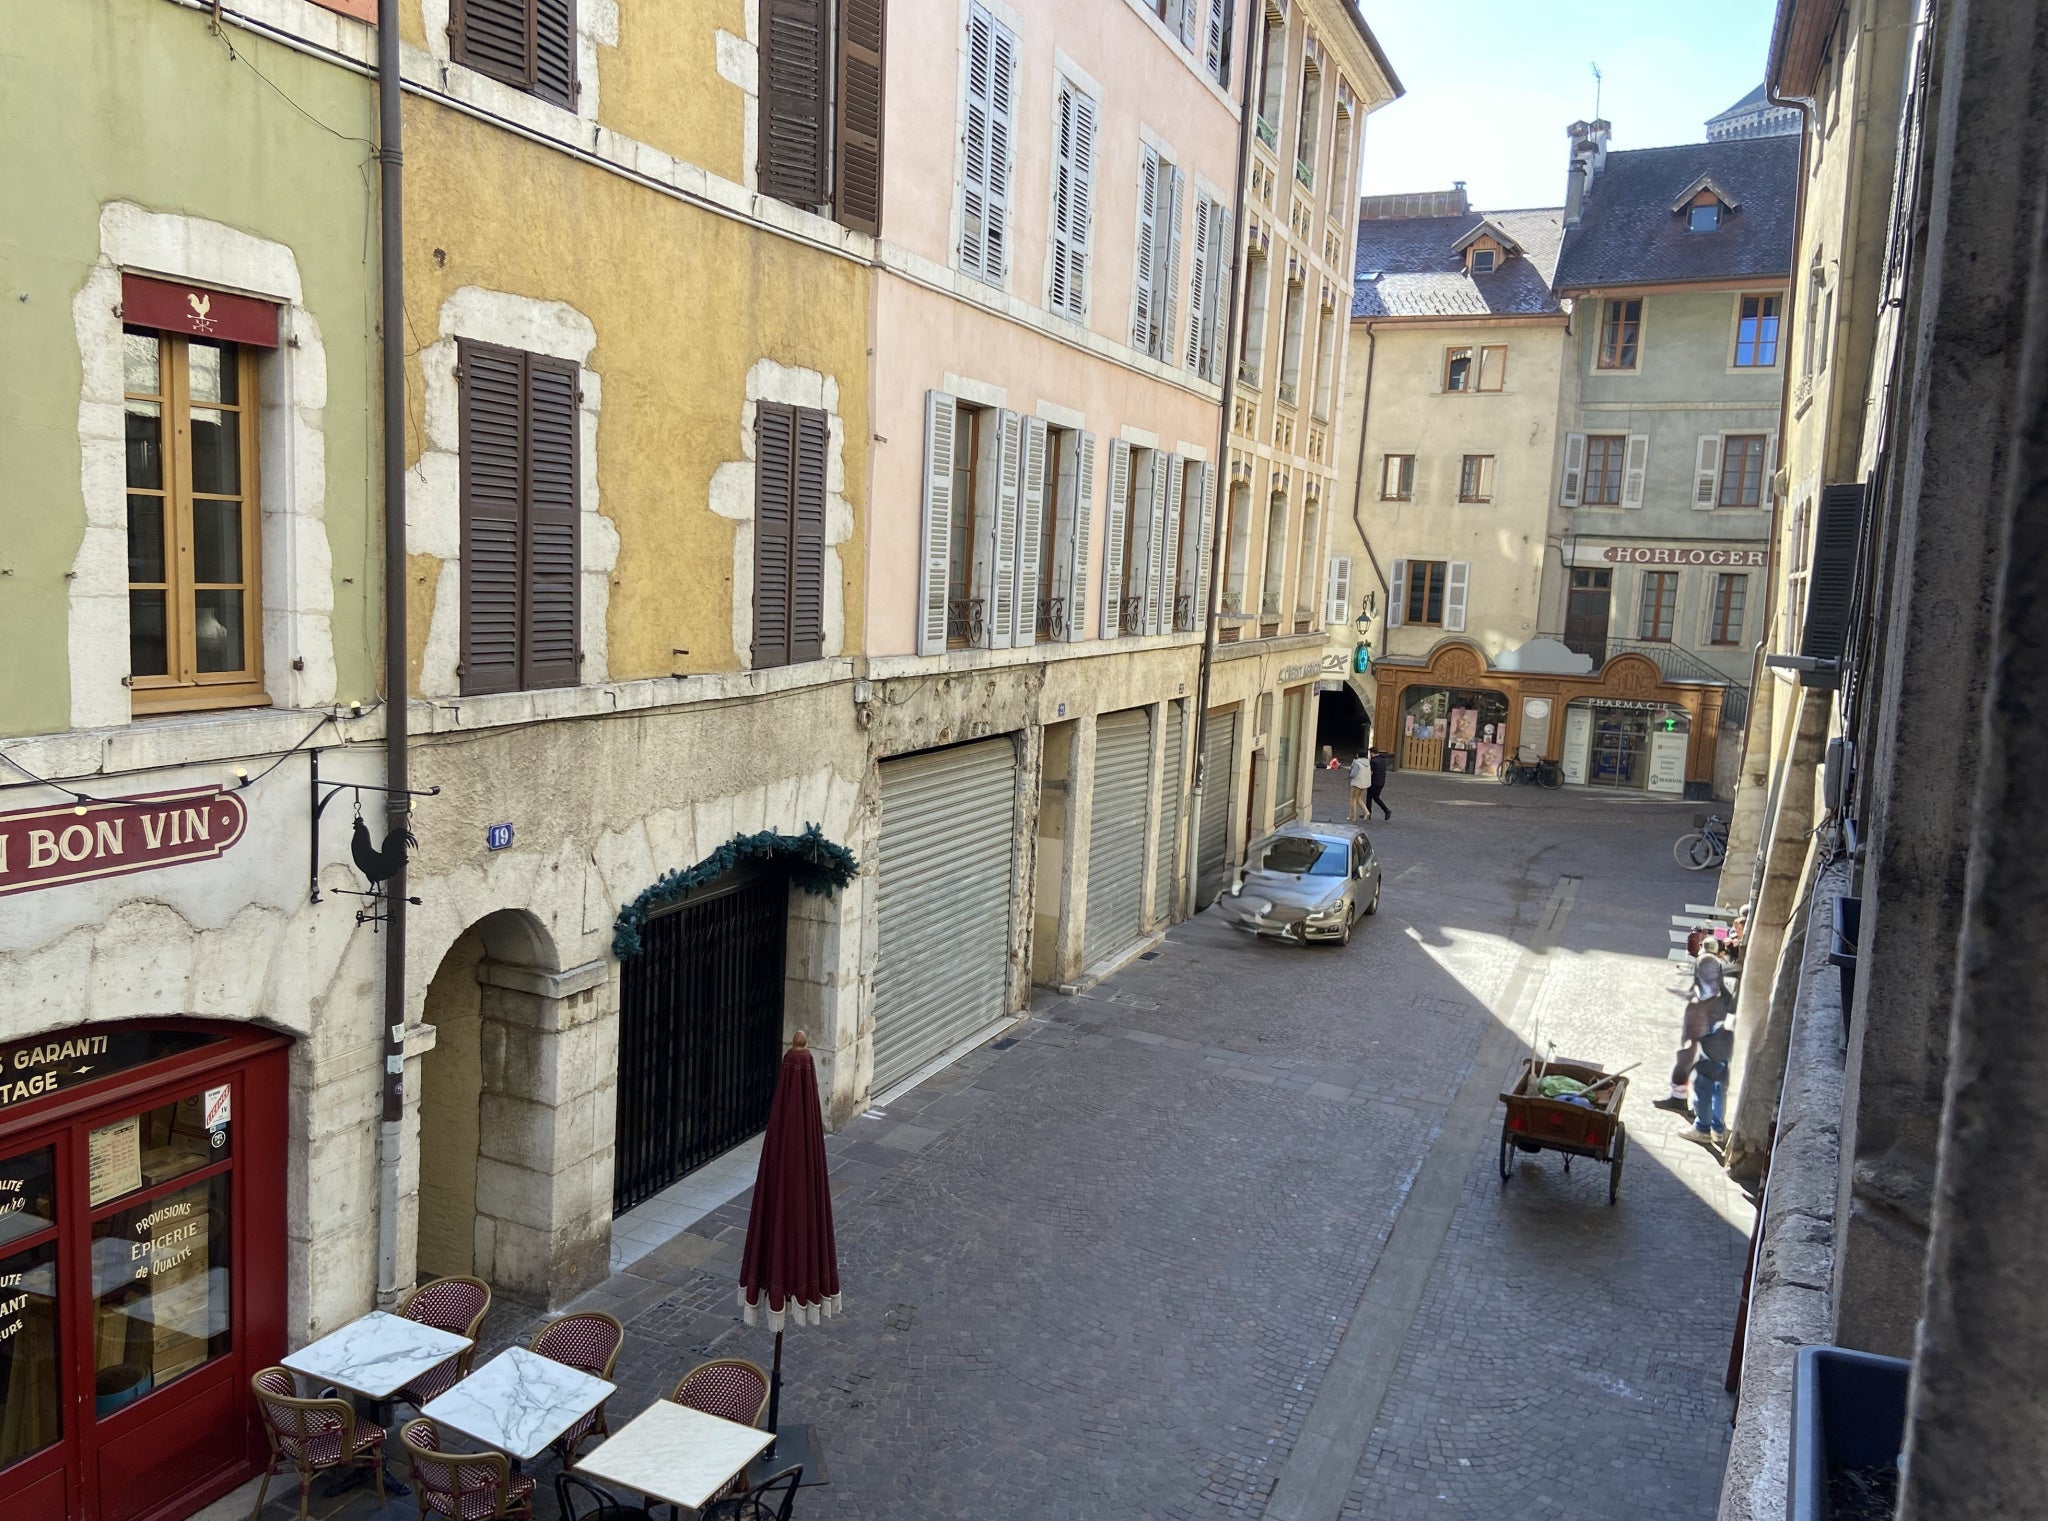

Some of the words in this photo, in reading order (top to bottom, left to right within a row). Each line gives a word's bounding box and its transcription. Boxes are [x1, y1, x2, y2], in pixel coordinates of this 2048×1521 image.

[1616, 548, 1763, 565] HORLOGER
[1588, 698, 1669, 711] PHARMACIE
[28, 818, 125, 869] BON
[140, 806, 211, 850] VIN
[494, 827, 509, 847] 19
[13, 1035, 108, 1070] GARANTI
[0, 1070, 58, 1104] TAGE
[135, 1202, 192, 1234] PROVISIONS
[131, 1222, 198, 1261] ÉPICERIE
[135, 1265, 149, 1279] de
